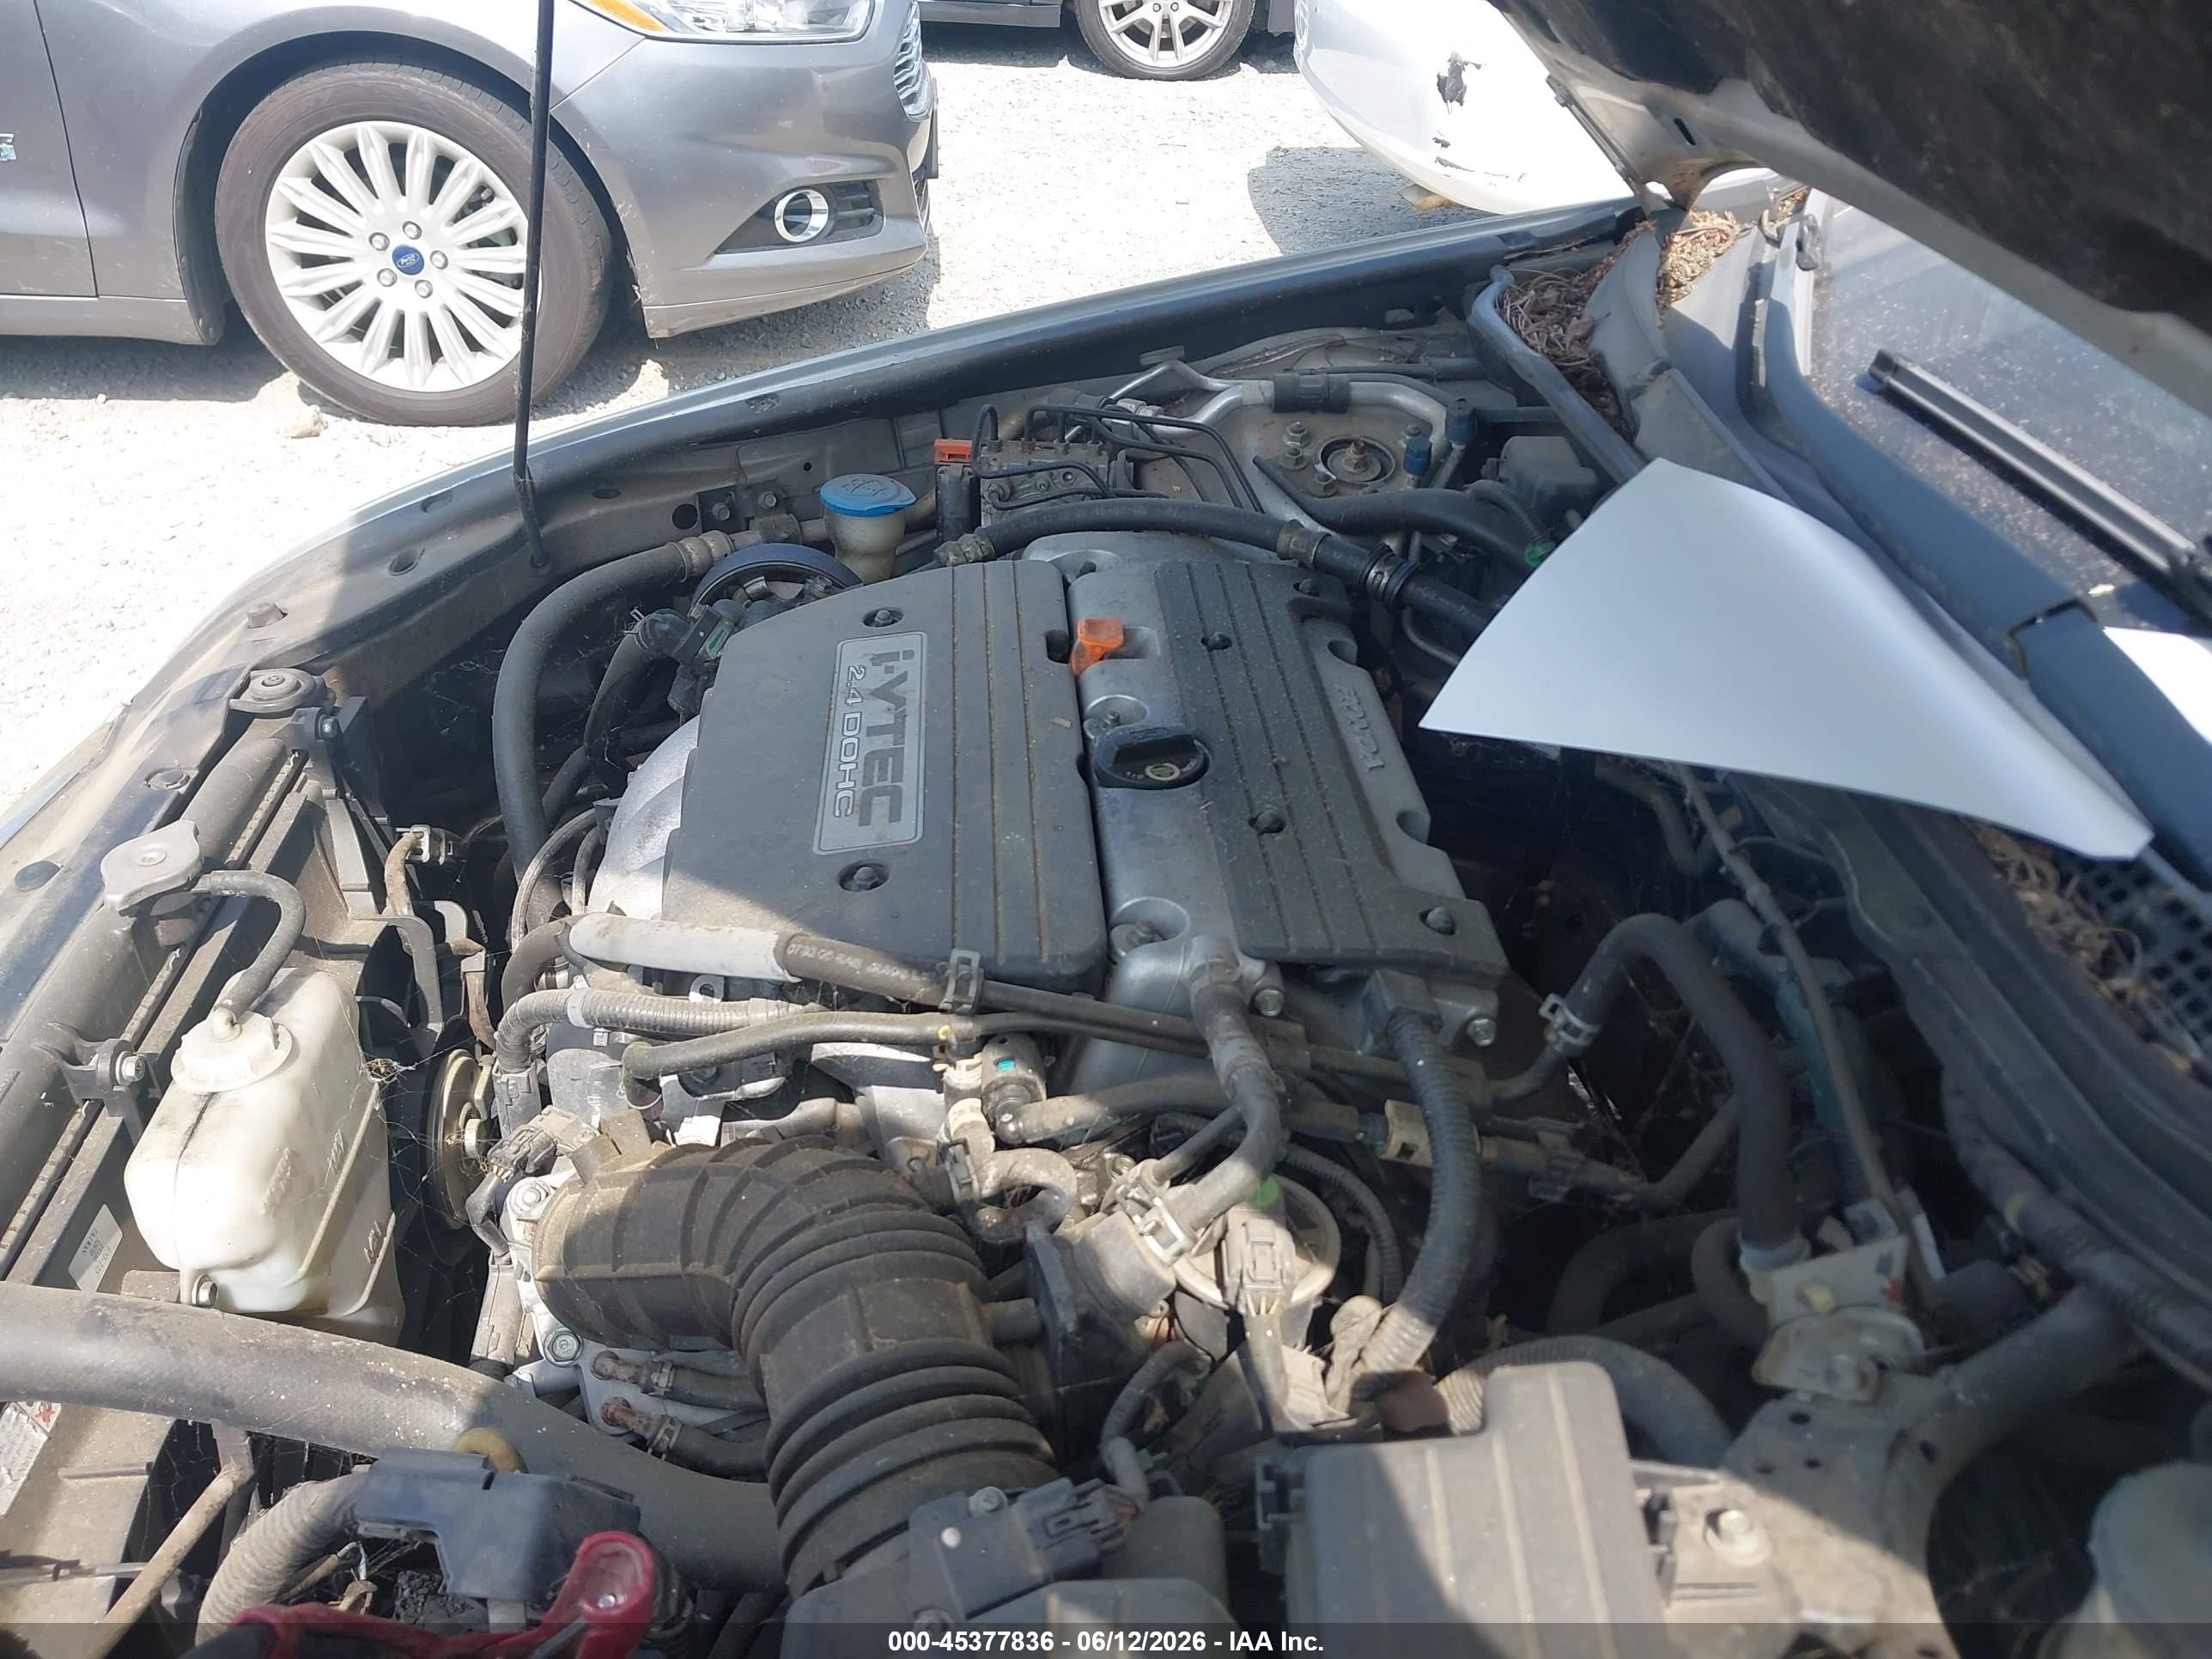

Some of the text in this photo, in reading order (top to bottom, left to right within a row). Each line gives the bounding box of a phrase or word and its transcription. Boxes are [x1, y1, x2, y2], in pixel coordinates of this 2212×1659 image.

[833, 665, 866, 818] 2.4 DOHC
[859, 649, 915, 828] i-VTEC
